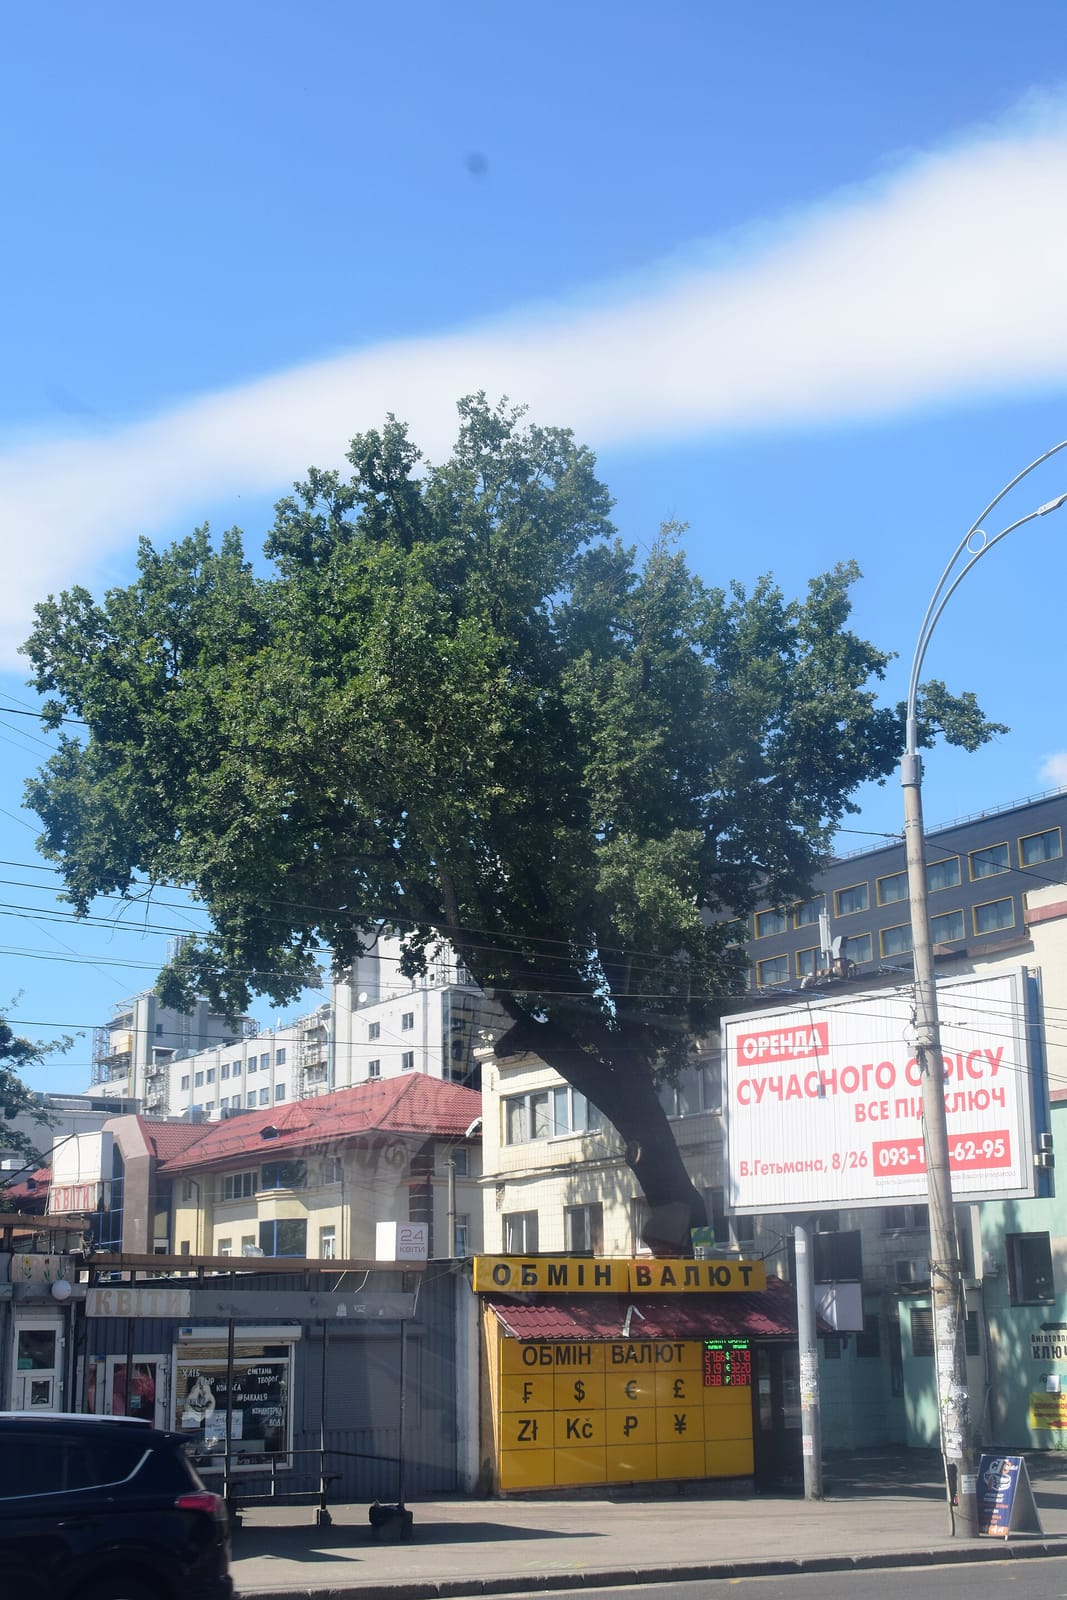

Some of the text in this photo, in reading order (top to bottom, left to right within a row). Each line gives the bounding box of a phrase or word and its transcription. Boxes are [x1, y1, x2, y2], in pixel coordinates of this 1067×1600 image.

[742, 1028, 824, 1060] ОРЕНДА
[736, 1061, 897, 1106] СУЧАСНОГО
[854, 1100, 890, 1123] ВСЕ
[739, 1151, 868, 1177] В.Гетьмана, 8/26
[400, 1229, 424, 1242] 24
[492, 1263, 754, 1287] ОБМІН ВАЛЮТ
[94, 1290, 182, 1315] КВІТИ
[522, 1343, 686, 1366] ОБМІН ВАЛЮТ
[574, 1380, 585, 1402] $
[625, 1380, 638, 1400] €
[673, 1378, 686, 1399] £
